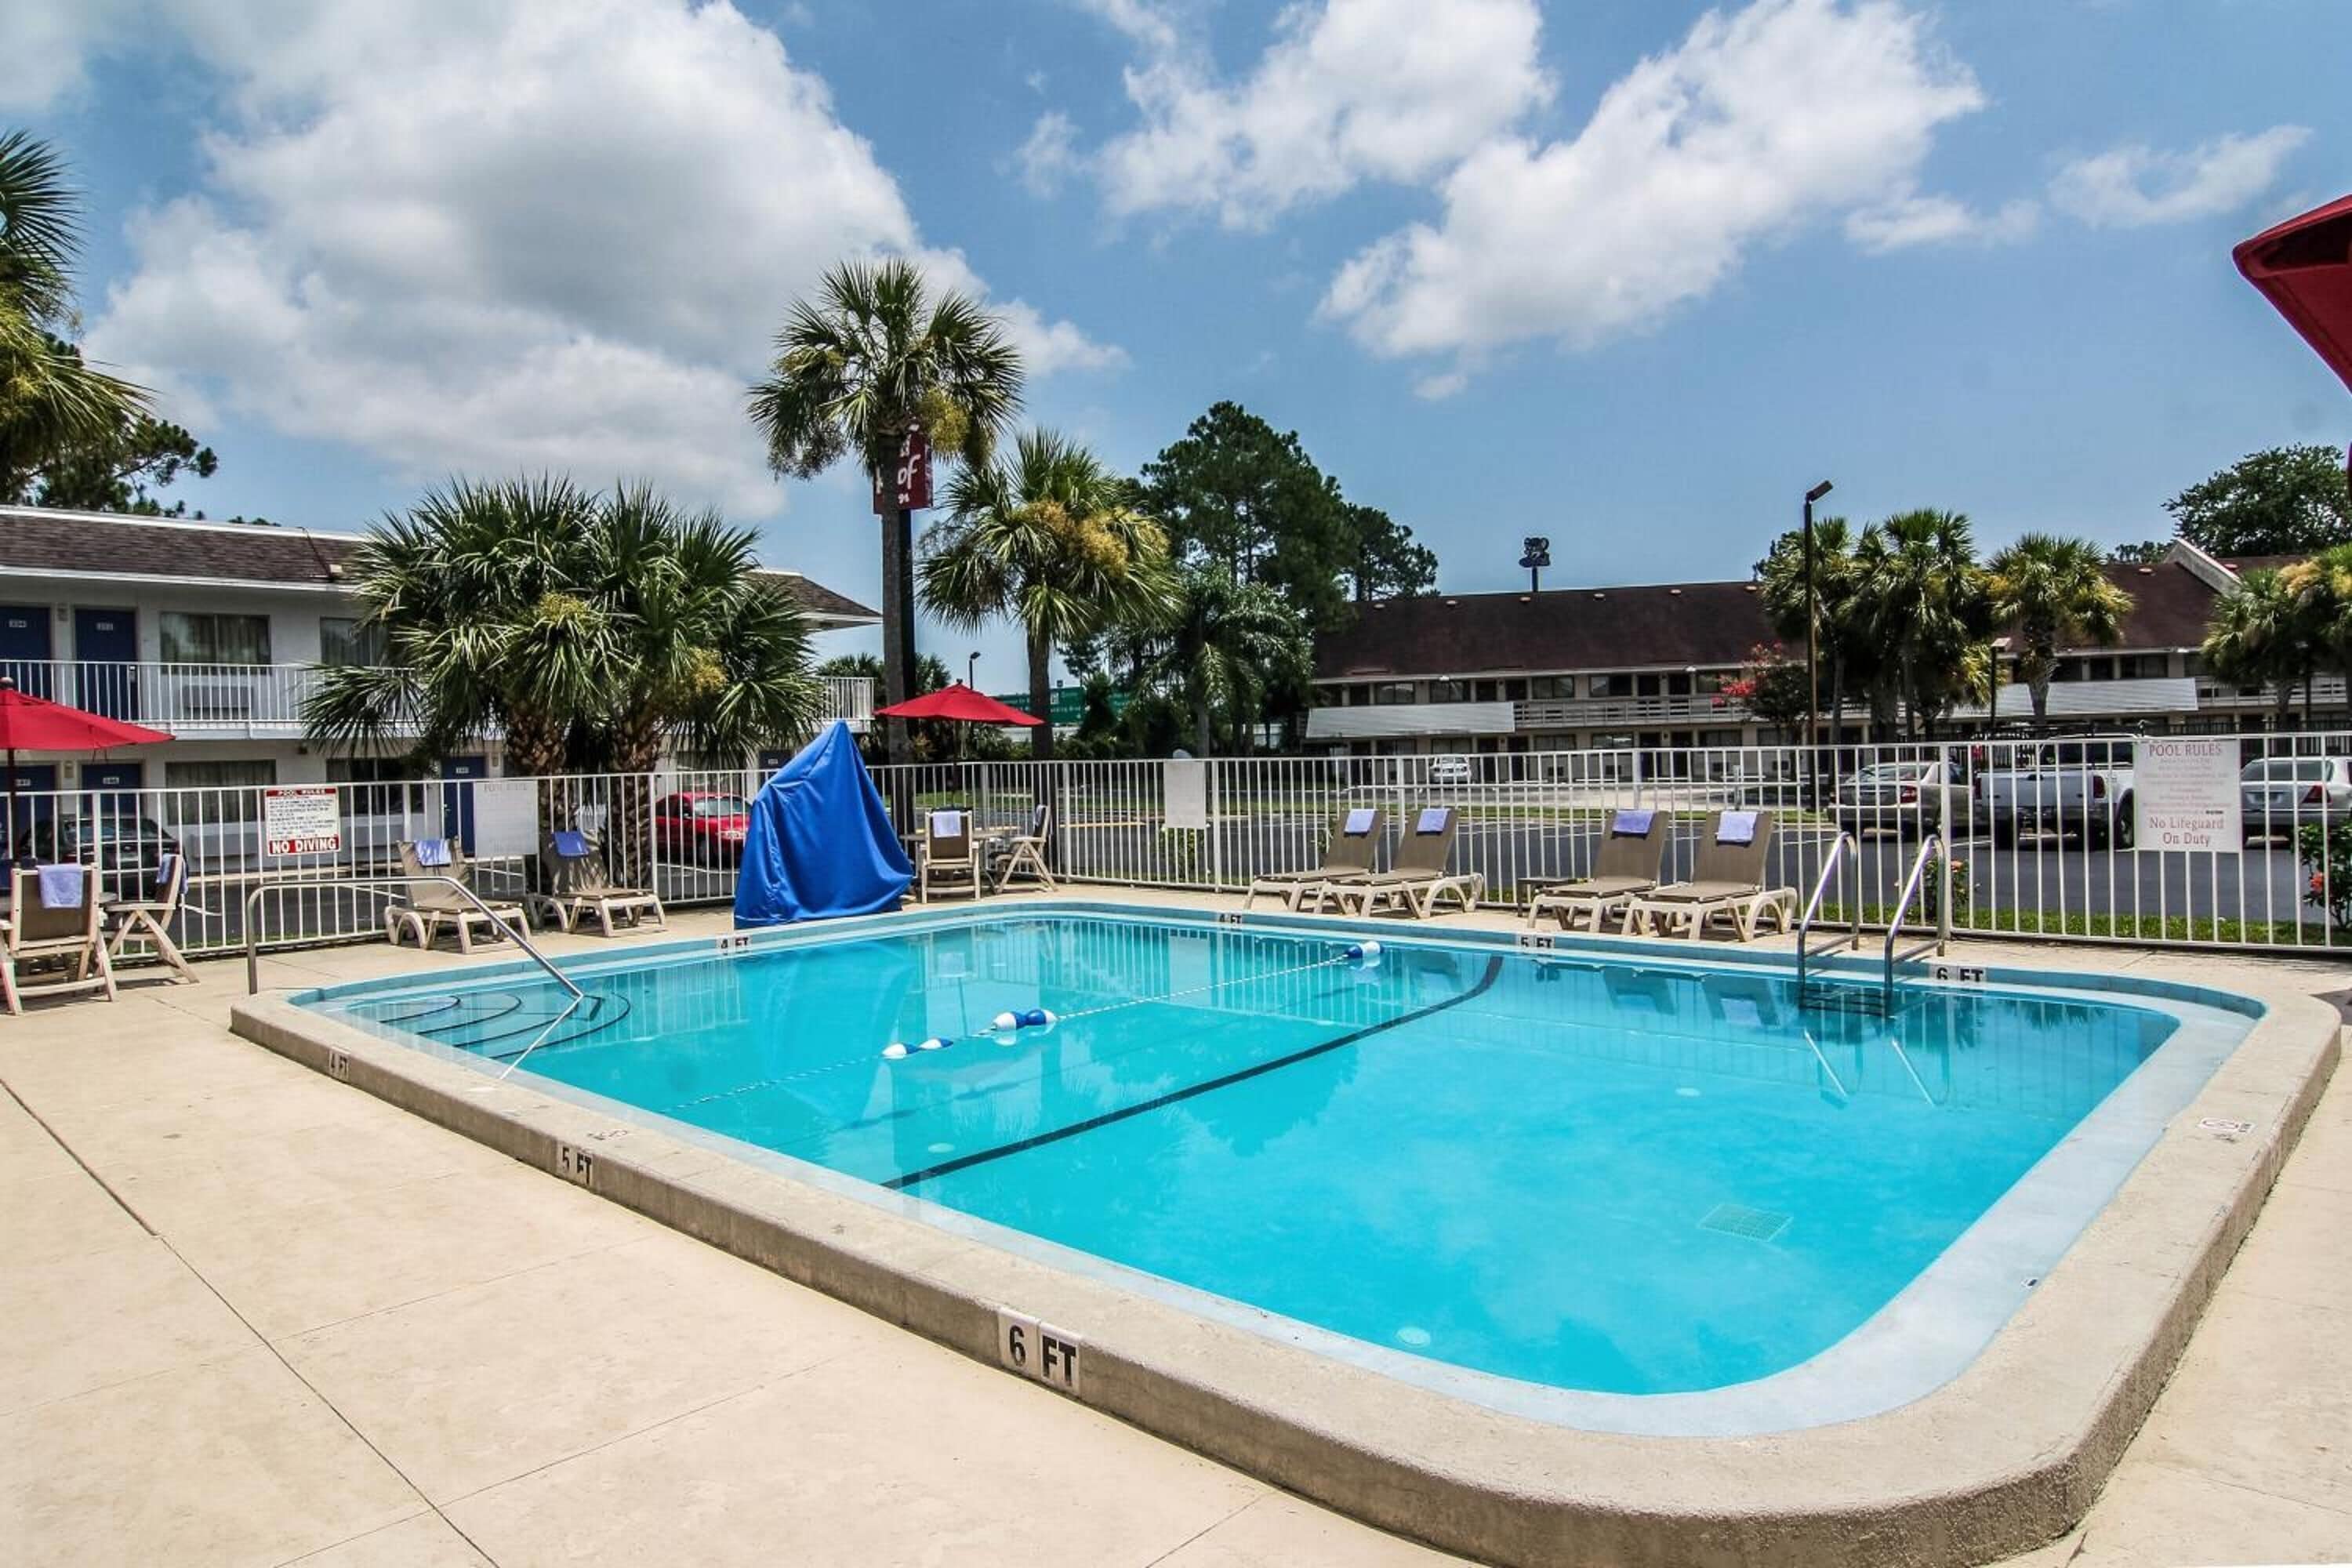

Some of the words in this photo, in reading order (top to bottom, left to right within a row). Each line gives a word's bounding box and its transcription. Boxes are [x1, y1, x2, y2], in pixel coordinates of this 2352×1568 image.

[2149, 744, 2182, 757] POOL
[2185, 742, 2221, 757] RULES
[2149, 817, 2166, 829] No
[2169, 816, 2224, 831] Lifeguard
[272, 840, 289, 854] NO
[295, 835, 336, 852] DIVING
[2163, 832, 2180, 844] On
[2183, 832, 2210, 847] Duty
[1537, 937, 1552, 949] FT
[1960, 968, 1984, 982] FT
[561, 1147, 570, 1172] 5
[576, 1152, 592, 1185] FT
[1009, 1325, 1026, 1367] 6
[1042, 1335, 1076, 1387] FT
